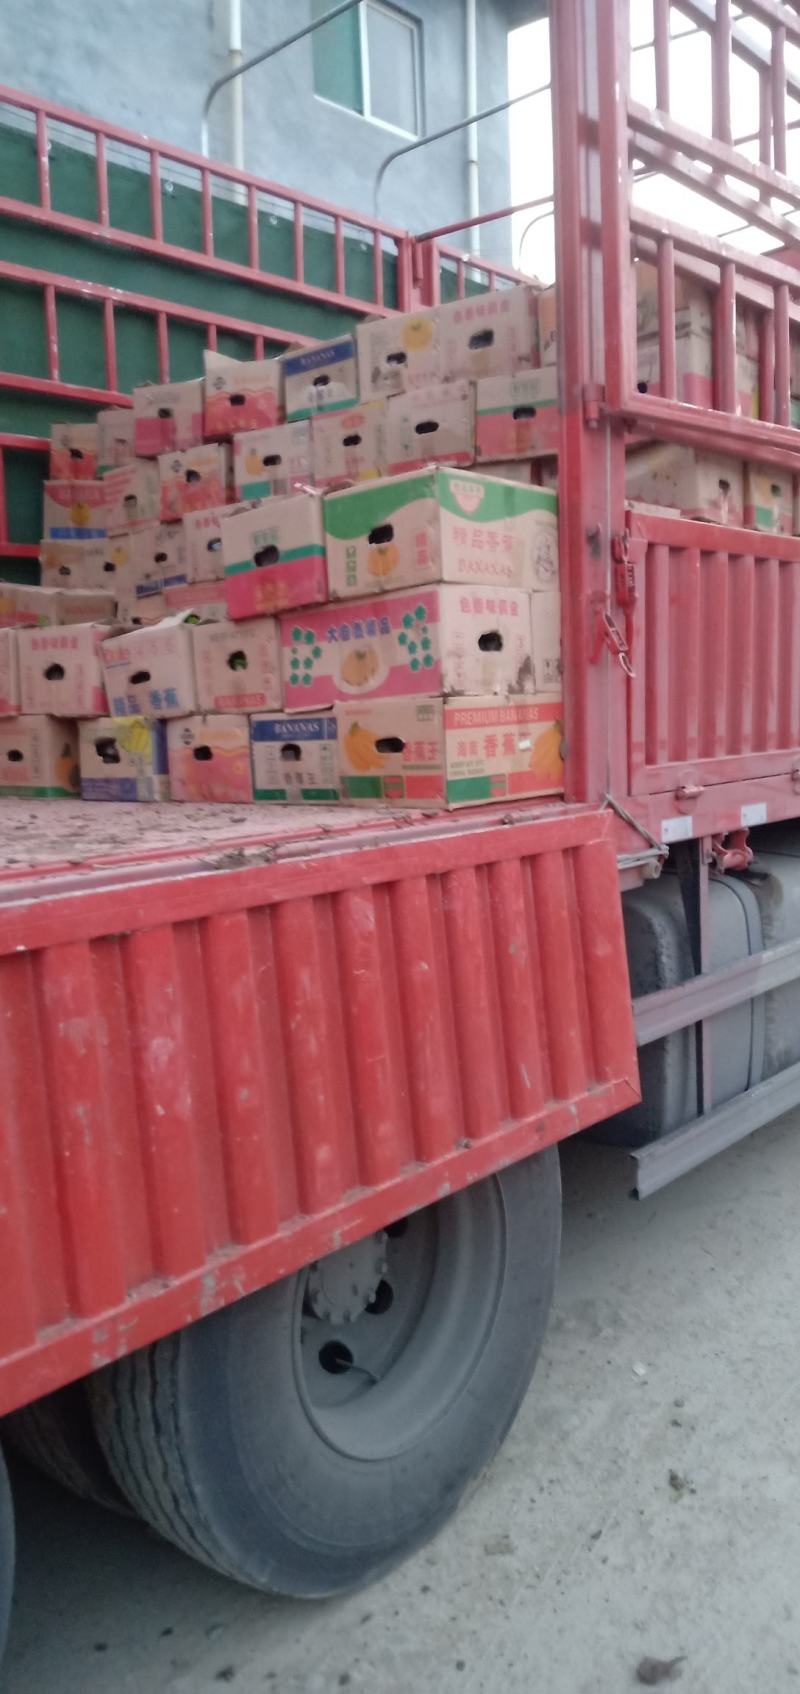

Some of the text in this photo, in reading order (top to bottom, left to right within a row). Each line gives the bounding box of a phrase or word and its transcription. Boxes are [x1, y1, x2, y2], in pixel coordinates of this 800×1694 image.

[454, 710, 499, 726] PREMIUM
[500, 707, 539, 723] BANANAS
[273, 721, 320, 735] BANANAS
